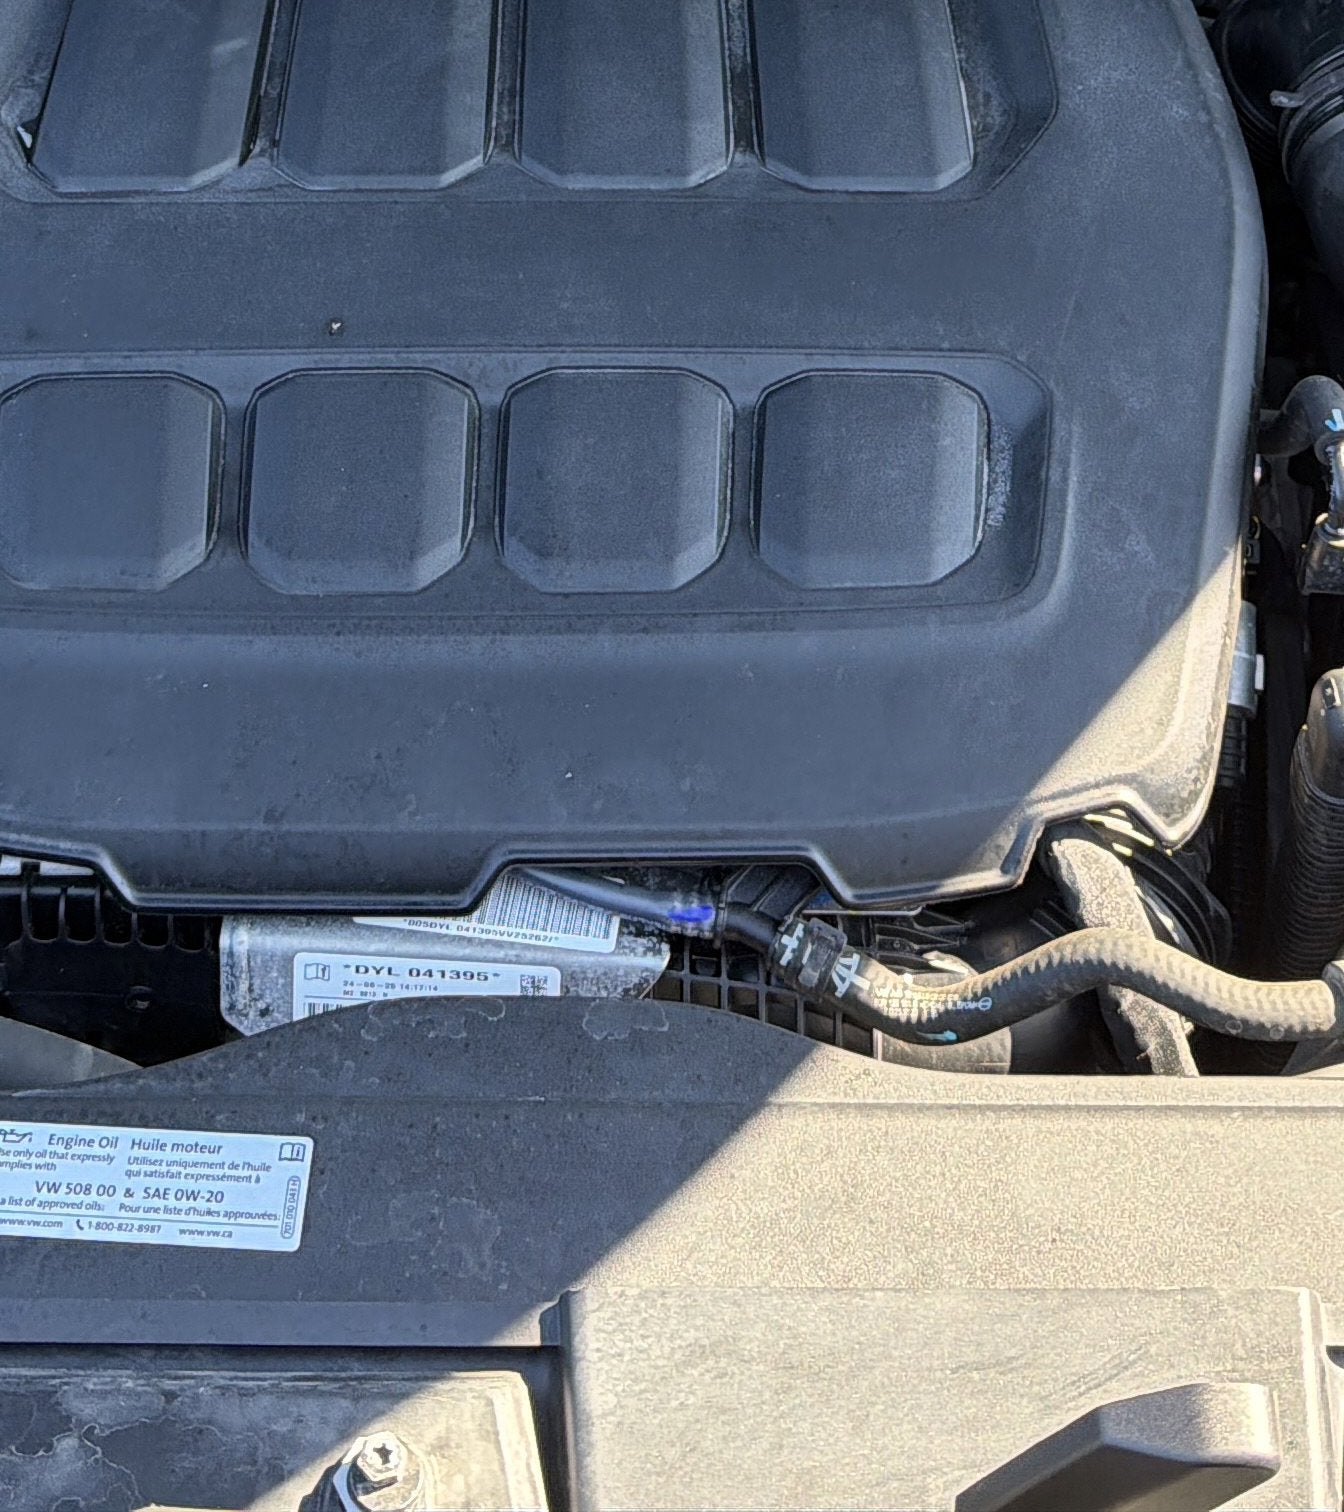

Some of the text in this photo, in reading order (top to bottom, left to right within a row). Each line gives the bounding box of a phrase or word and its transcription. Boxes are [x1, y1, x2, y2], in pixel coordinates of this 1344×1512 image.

[48, 1133, 119, 1150] Engine Oil
[130, 1138, 223, 1155] Huile moteur
[12, 1149, 34, 1160] only
[34, 1149, 47, 1159] oil
[49, 1150, 68, 1160] that
[71, 1152, 115, 1165] expressly
[128, 1155, 272, 1172] Utilisez uniquement de l'huile
[34, 1161, 56, 1171] with
[125, 1169, 261, 1183] qui satisfait expressément à
[35, 1180, 224, 1204] VW 508 00 & SAE 0W-20
[0, 1198, 6, 1206] a
[8, 1196, 22, 1207] list
[24, 1197, 36, 1207] of
[37, 1199, 83, 1211] approved
[119, 1202, 142, 1213] Pour
[143, 1205, 161, 1215] une
[163, 1205, 182, 1215] liste
[184, 1207, 220, 1218] d'huiles
[0, 1218, 233, 1238] www.vw.com 1-800-822-8987 www.vw.ca
